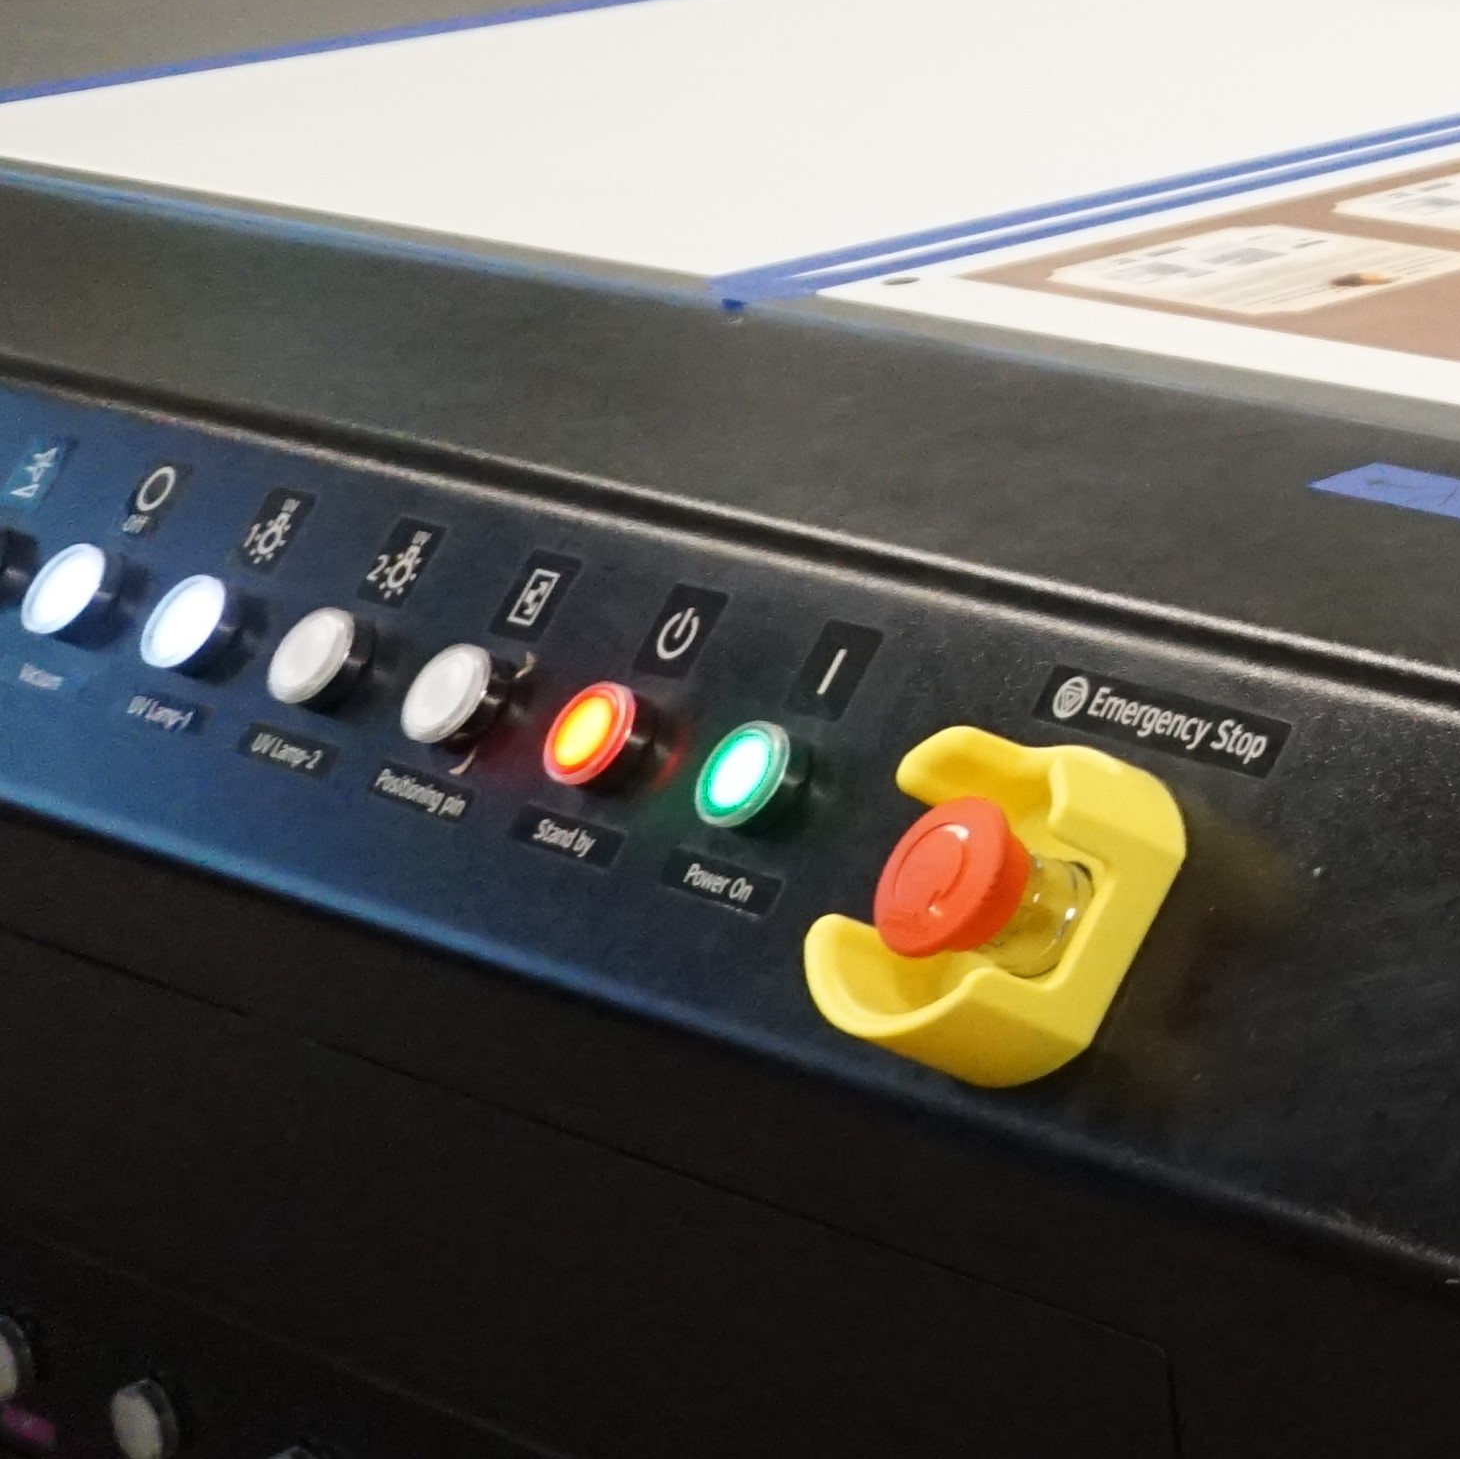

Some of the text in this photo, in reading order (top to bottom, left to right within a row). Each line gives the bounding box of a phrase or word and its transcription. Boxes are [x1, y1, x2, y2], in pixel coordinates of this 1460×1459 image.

[366, 553, 390, 581] 2
[127, 694, 151, 717] UV
[1086, 686, 1269, 765] Emergency Stop
[250, 731, 325, 770] UV Lamp-2
[374, 768, 467, 818] Positioning pin
[531, 817, 597, 858] Stand by
[681, 862, 754, 904] Power On
